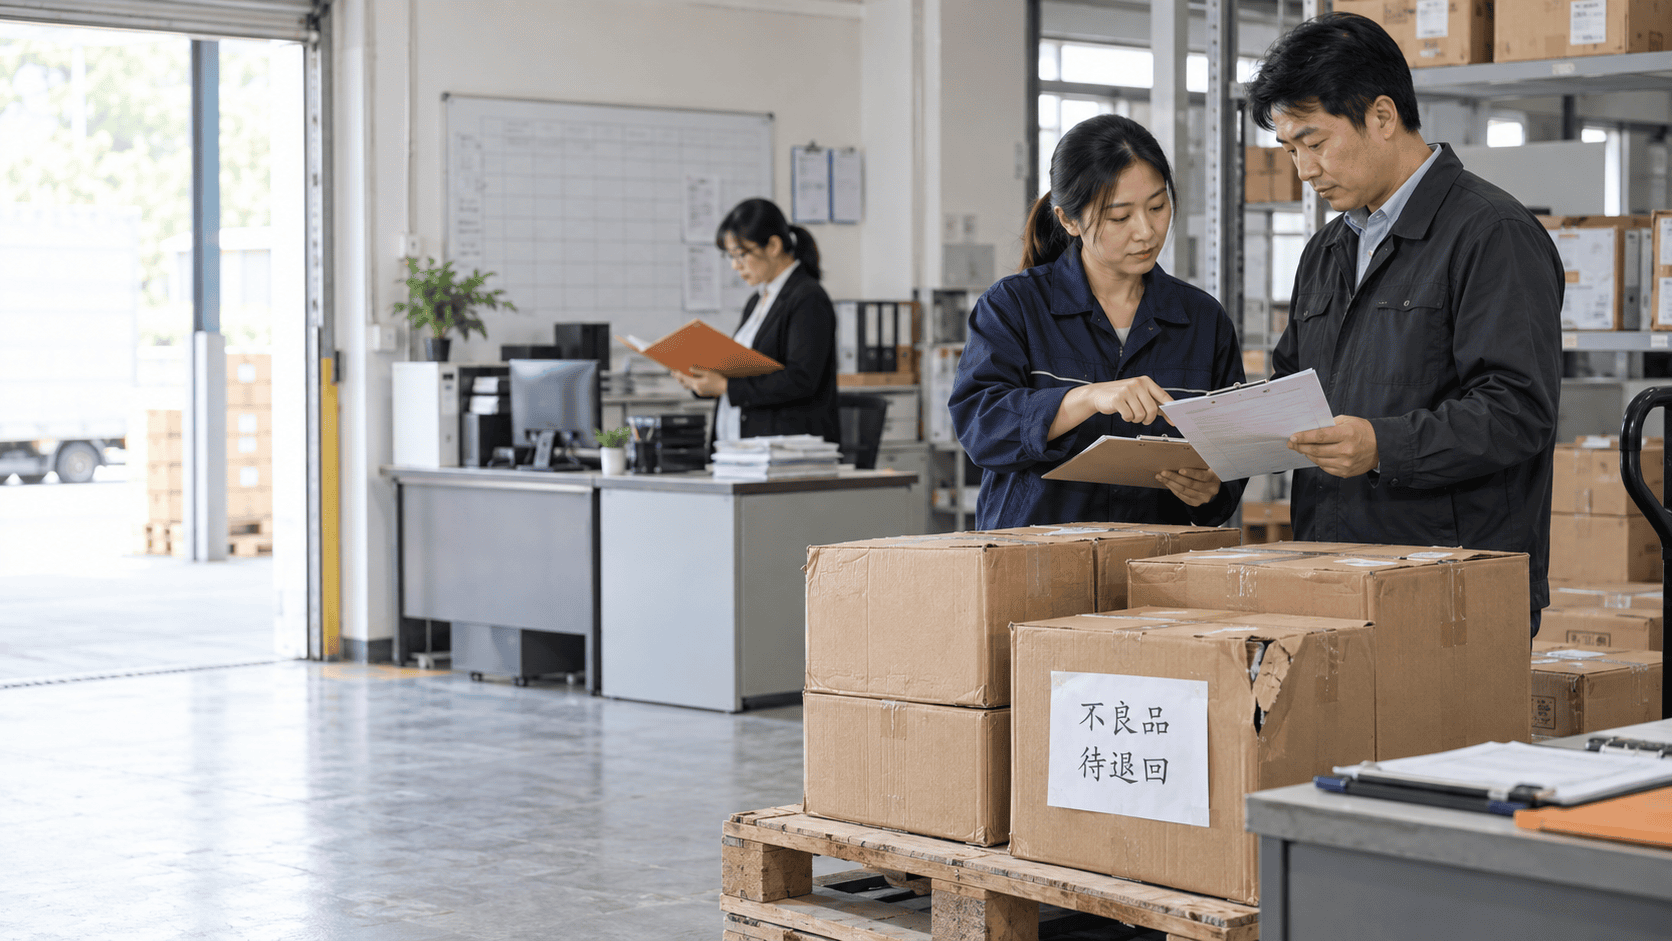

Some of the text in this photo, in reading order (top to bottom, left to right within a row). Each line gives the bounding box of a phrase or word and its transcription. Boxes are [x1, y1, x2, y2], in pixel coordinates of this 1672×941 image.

[1079, 700, 1170, 736] 不良品
[1078, 746, 1169, 785] 待退回
